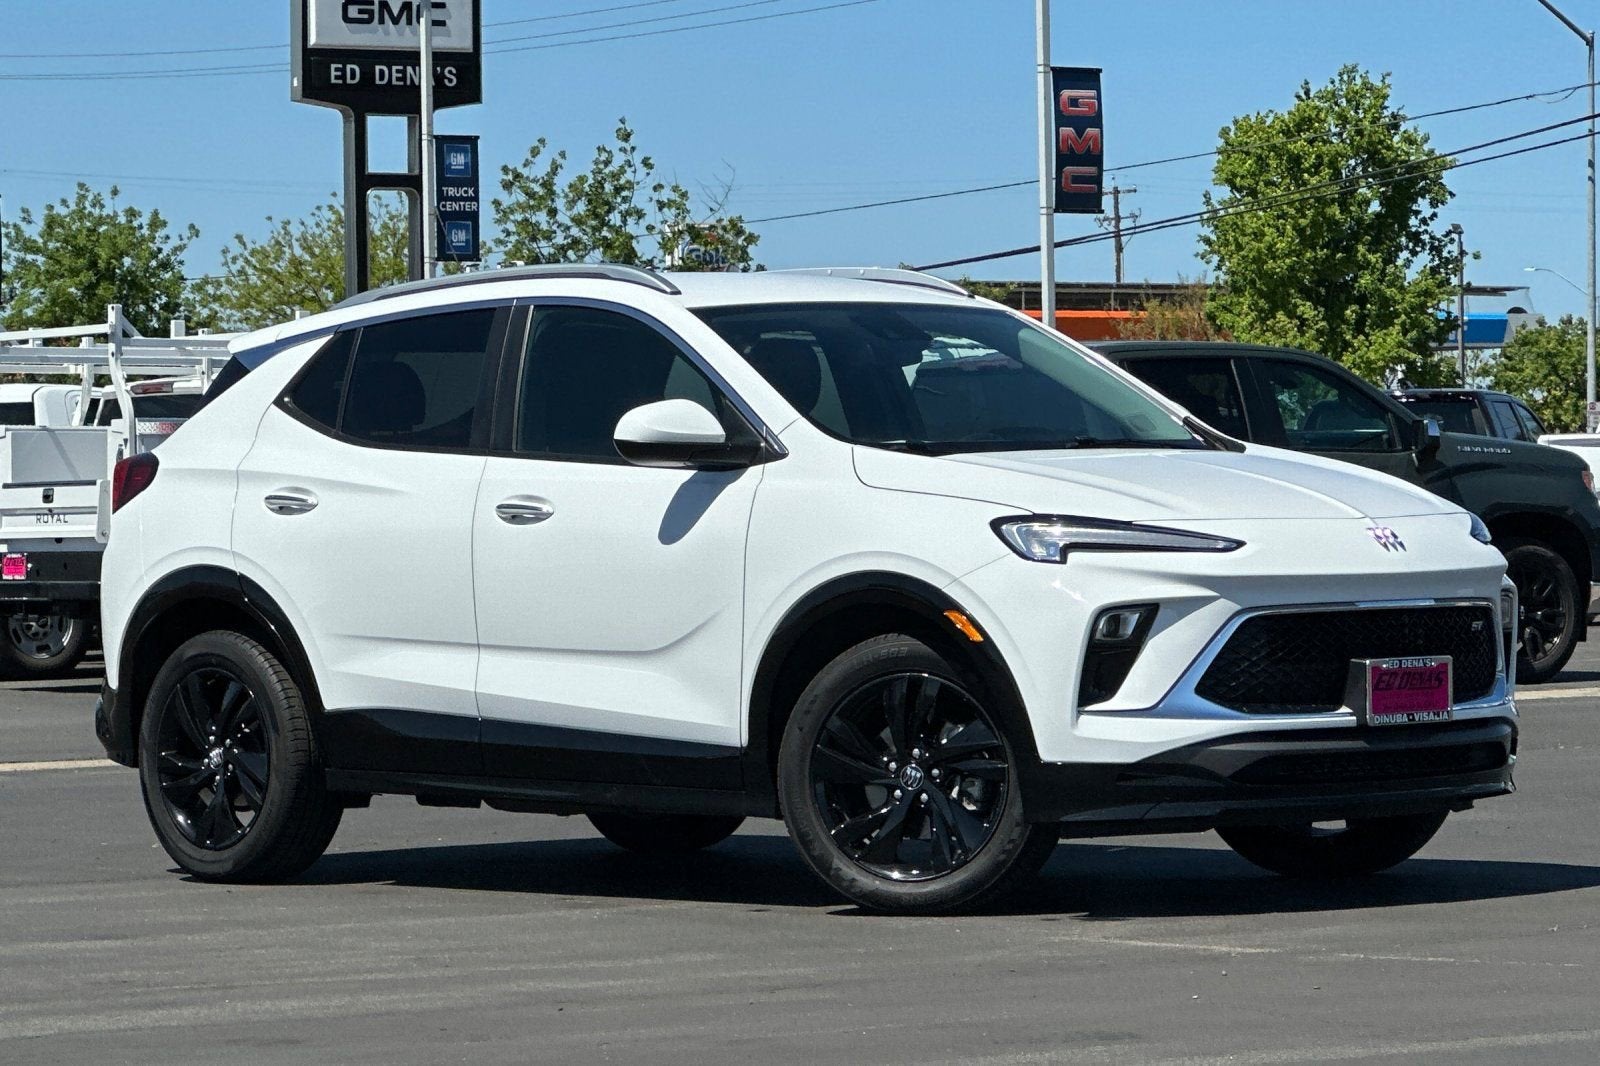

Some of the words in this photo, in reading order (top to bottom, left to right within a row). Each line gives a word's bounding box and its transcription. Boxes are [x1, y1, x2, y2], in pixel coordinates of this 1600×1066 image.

[342, 0, 447, 27] GMC
[330, 63, 361, 84] ED
[374, 64, 458, 87] DEN'S
[1059, 89, 1101, 193] GMC
[450, 152, 465, 166] GM
[442, 187, 475, 197] TRUCK
[439, 201, 478, 211] CENTER
[451, 229, 466, 242] GM
[35, 514, 68, 523] ROYAL
[1388, 660, 1400, 669] ED
[1401, 658, 1431, 668] DENA'S
[1374, 713, 1409, 724] DINUBA
[1413, 711, 1449, 721] VISALIA
